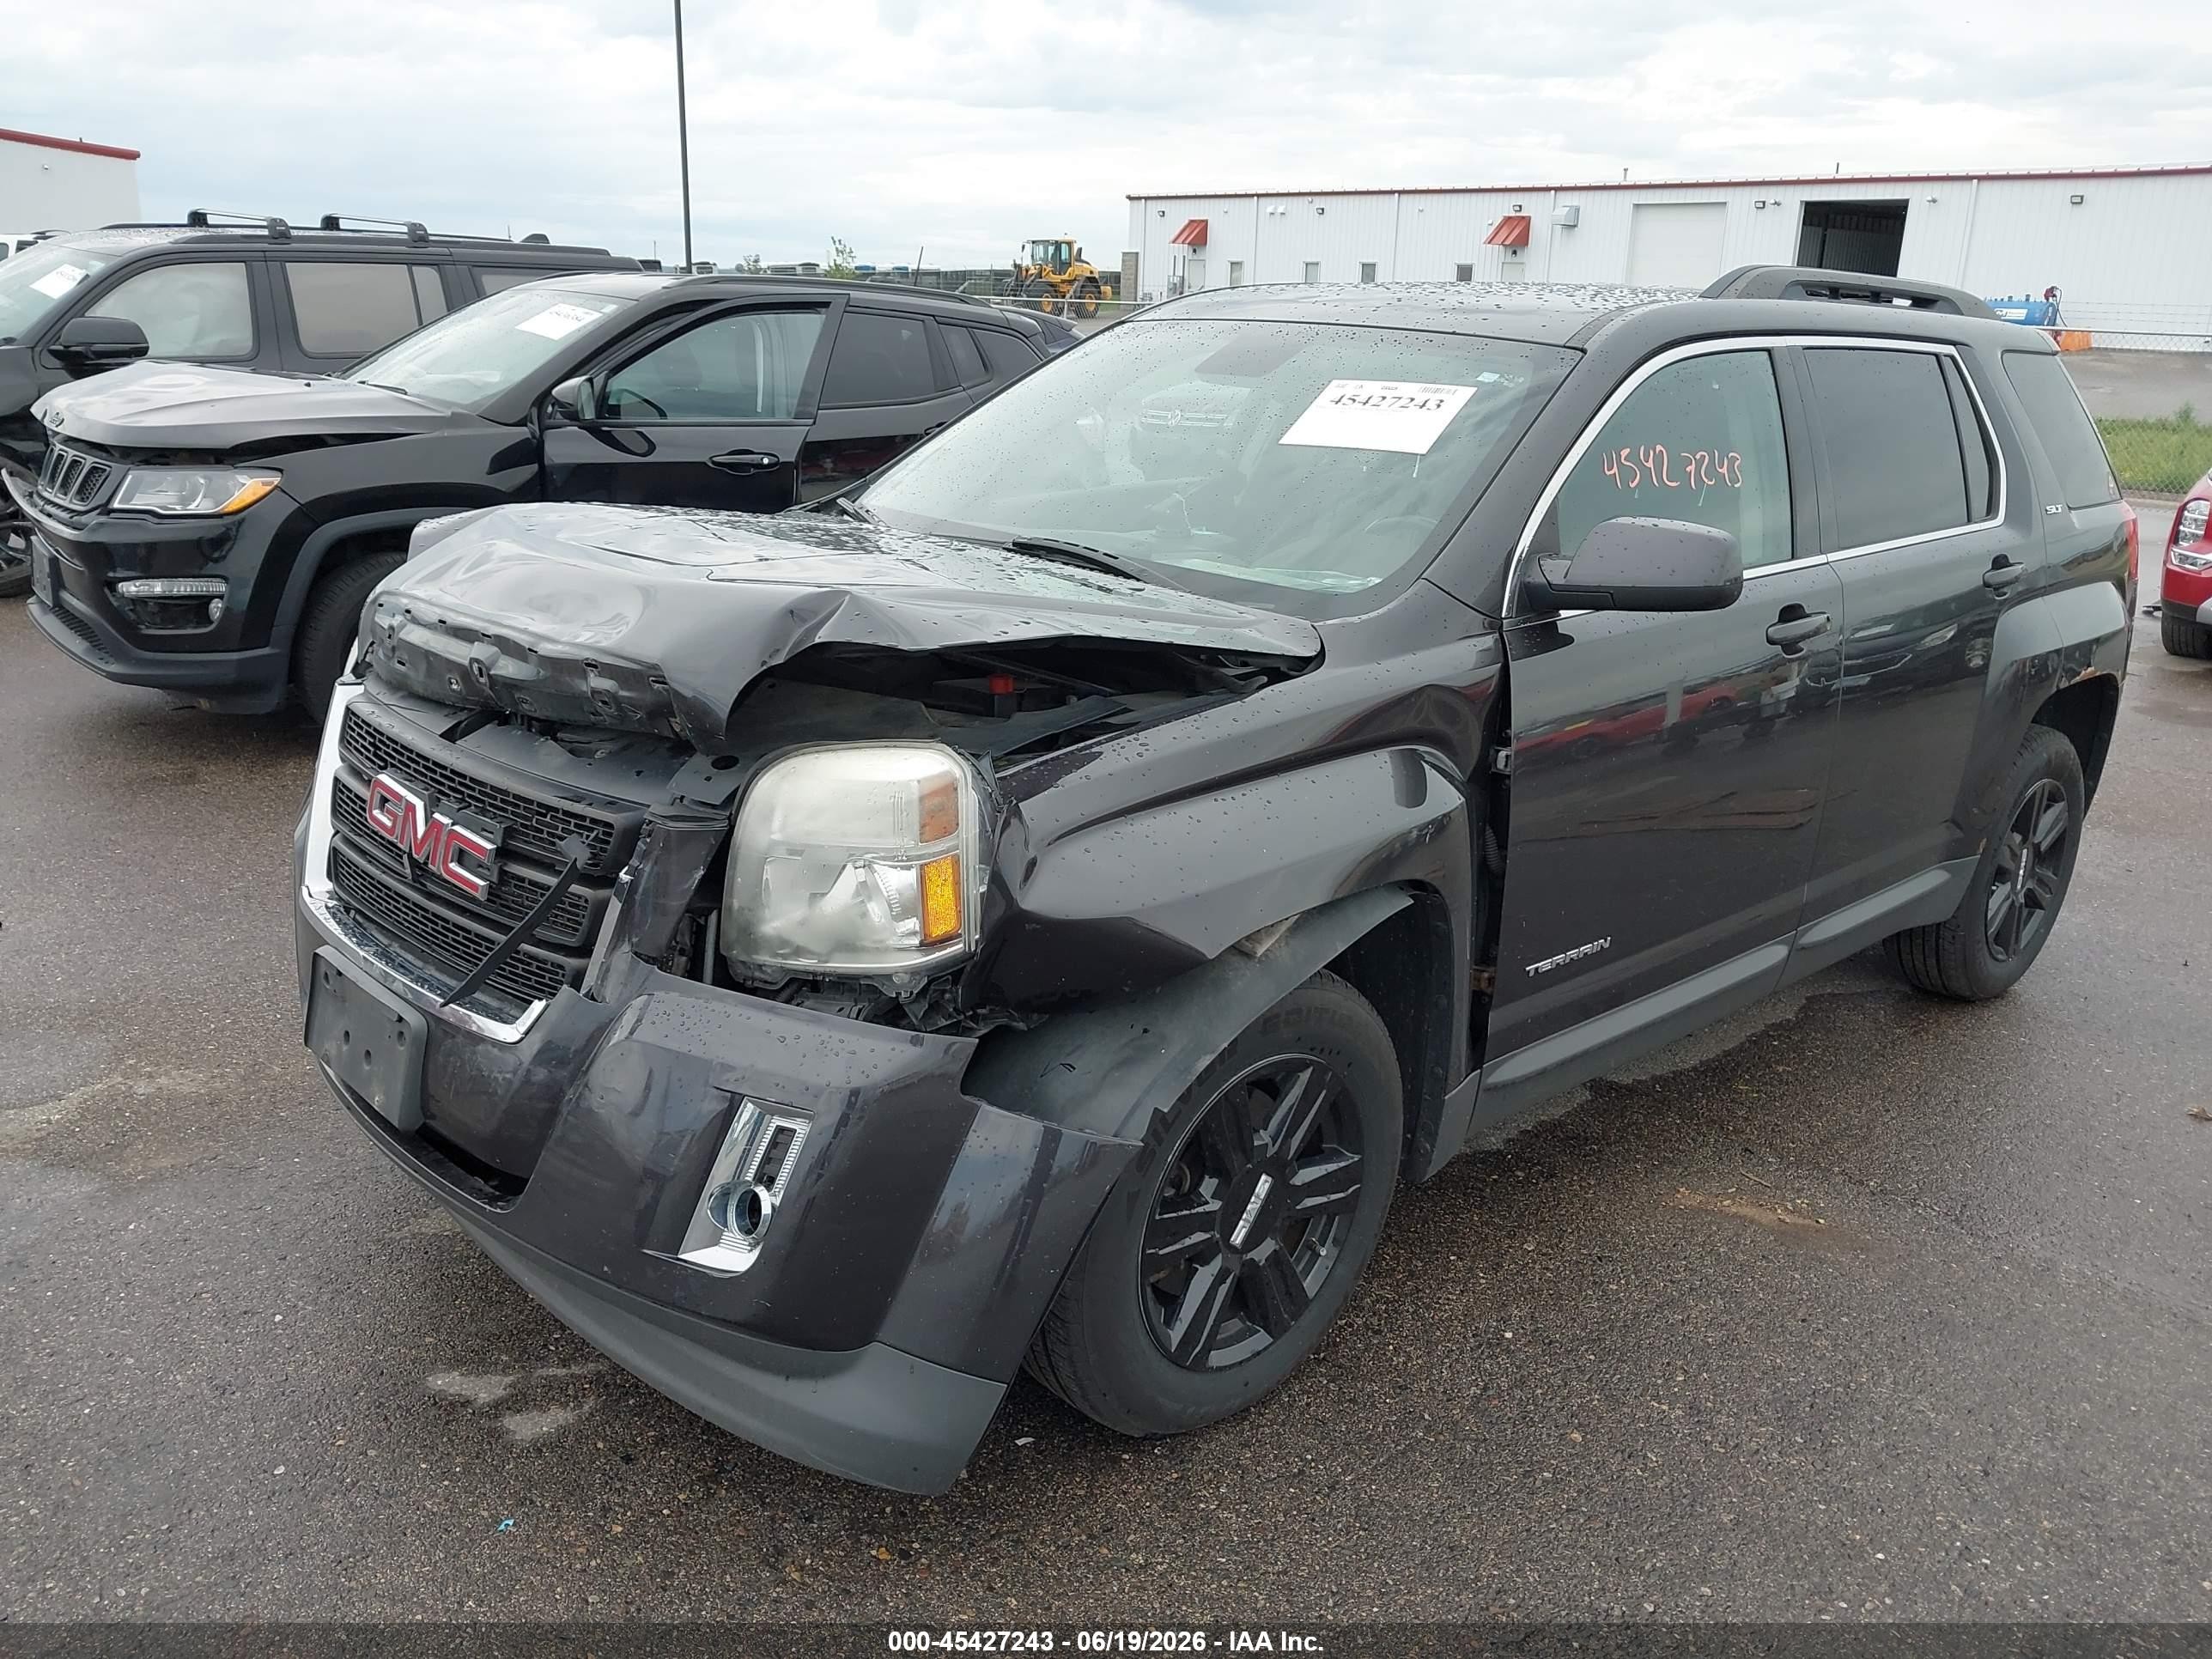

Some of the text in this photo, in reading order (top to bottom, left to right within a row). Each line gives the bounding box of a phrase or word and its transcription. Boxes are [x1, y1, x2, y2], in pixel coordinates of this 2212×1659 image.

[1330, 393, 1445, 411] 45427243
[367, 774, 497, 901] GMC
[1525, 936, 1611, 977] TERRAIN
